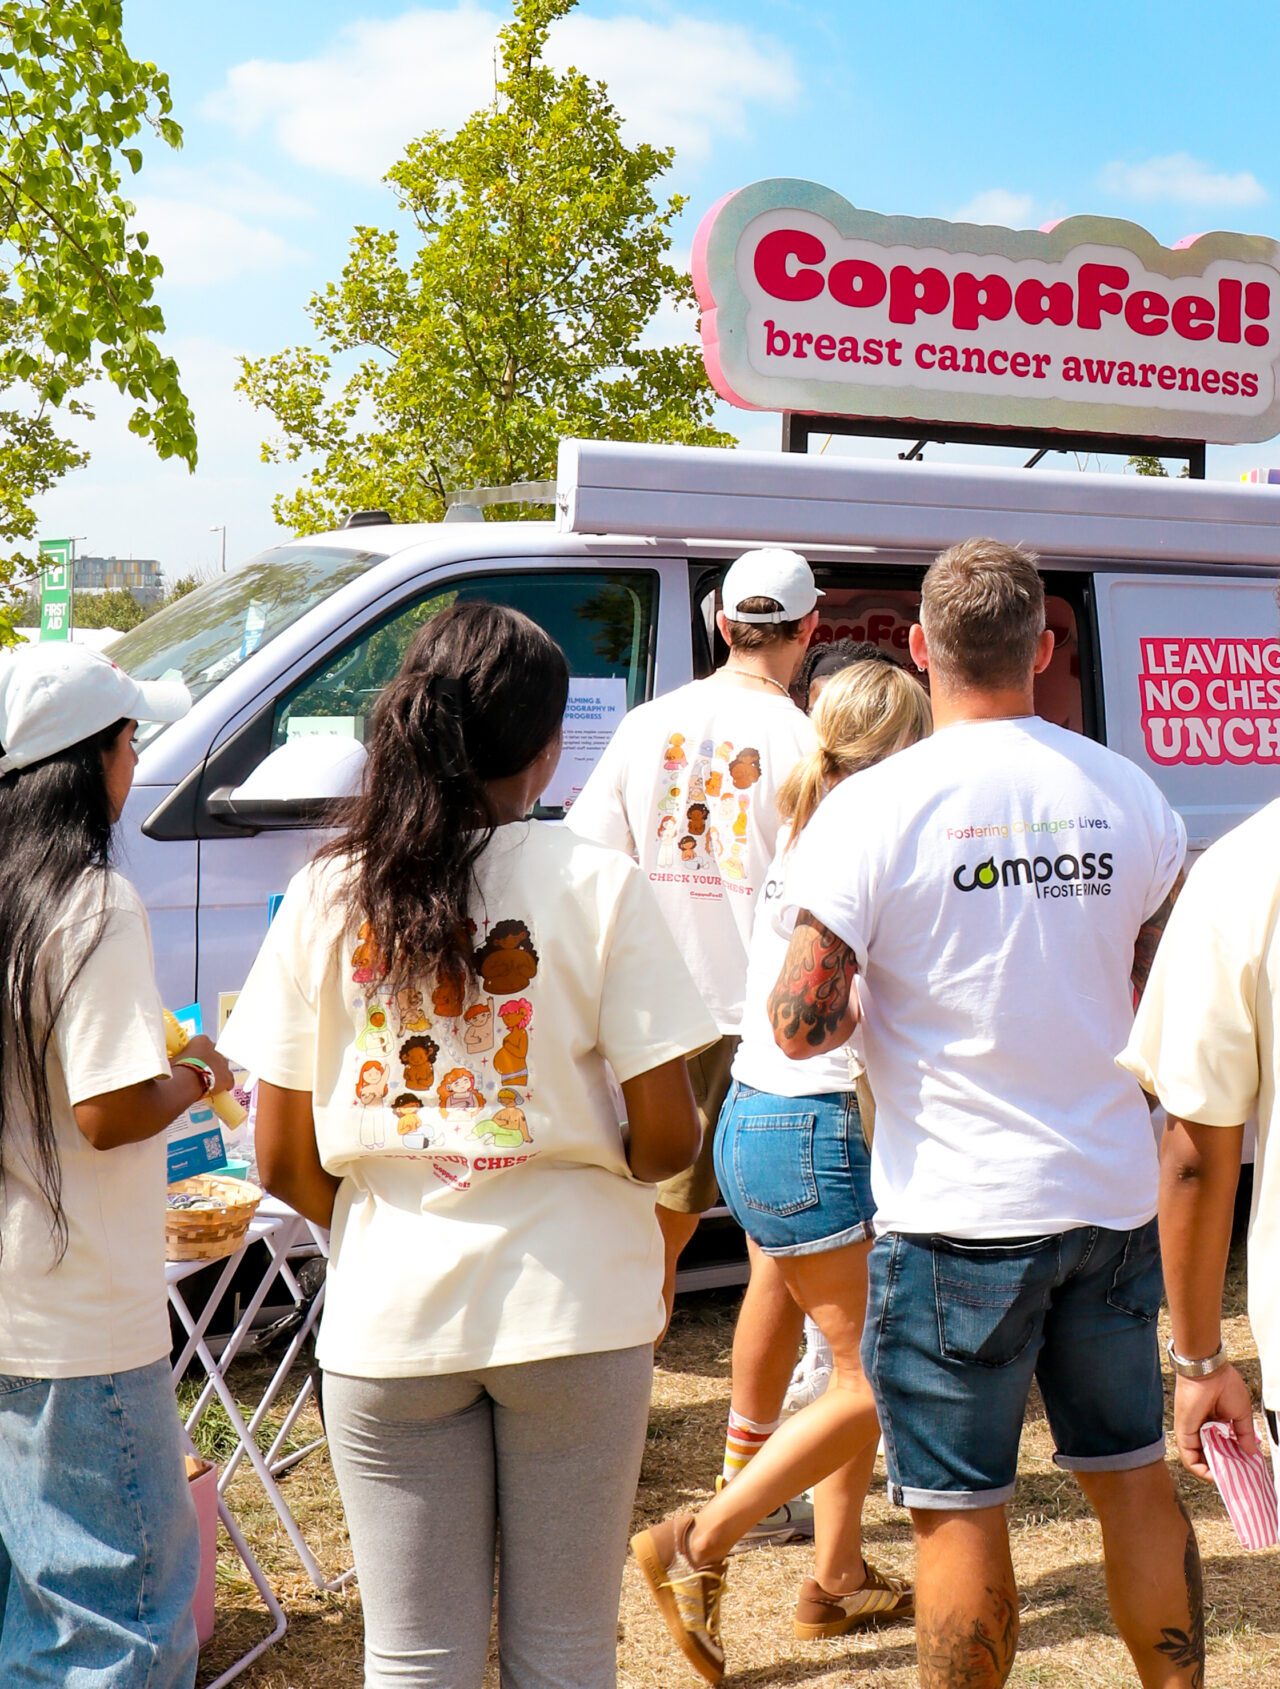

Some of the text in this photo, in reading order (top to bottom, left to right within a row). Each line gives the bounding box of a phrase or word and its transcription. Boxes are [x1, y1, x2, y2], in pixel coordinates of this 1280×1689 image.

[754, 229, 1270, 347] CoppaFeel!
[763, 319, 1259, 398] breast cancer awareness
[44, 603, 66, 616] FIRST
[47, 617, 63, 630] AID
[1144, 680, 1200, 711] NO
[946, 816, 1112, 840] Fostering Changes Lives.
[649, 873, 690, 883] CHECK
[692, 875, 722, 886] YOUR
[723, 880, 754, 896] CHEST
[953, 852, 1113, 899] compass
[1043, 883, 1112, 899] FOSTERING
